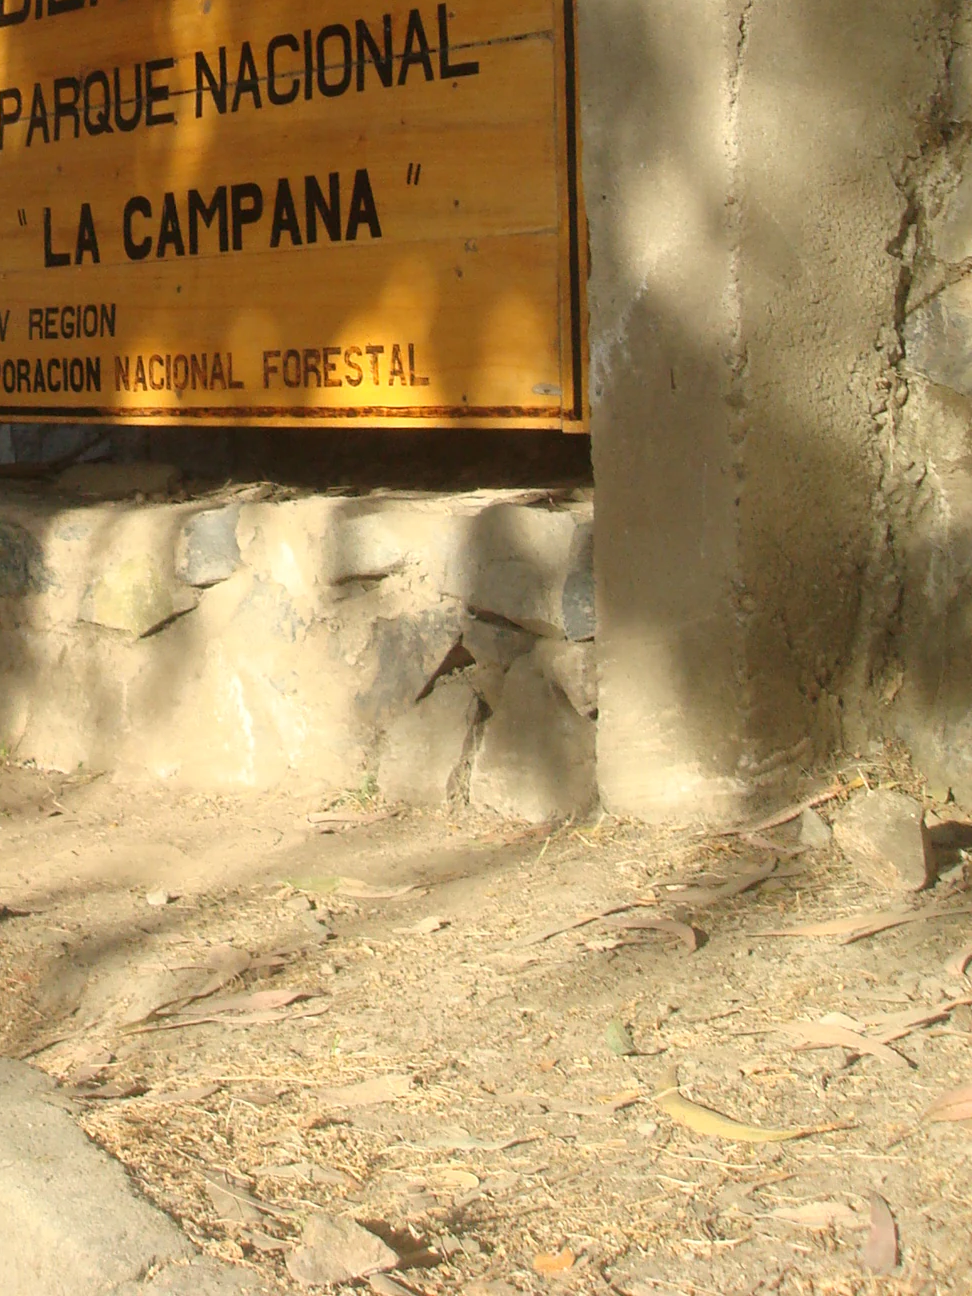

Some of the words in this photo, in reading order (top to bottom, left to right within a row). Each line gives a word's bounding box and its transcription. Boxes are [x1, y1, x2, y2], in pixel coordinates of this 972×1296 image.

[194, 3, 480, 120] NACIONAL
[28, 303, 117, 341] REGION
[114, 351, 245, 393] NACIONAL
[261, 341, 430, 390] FORESTAL
